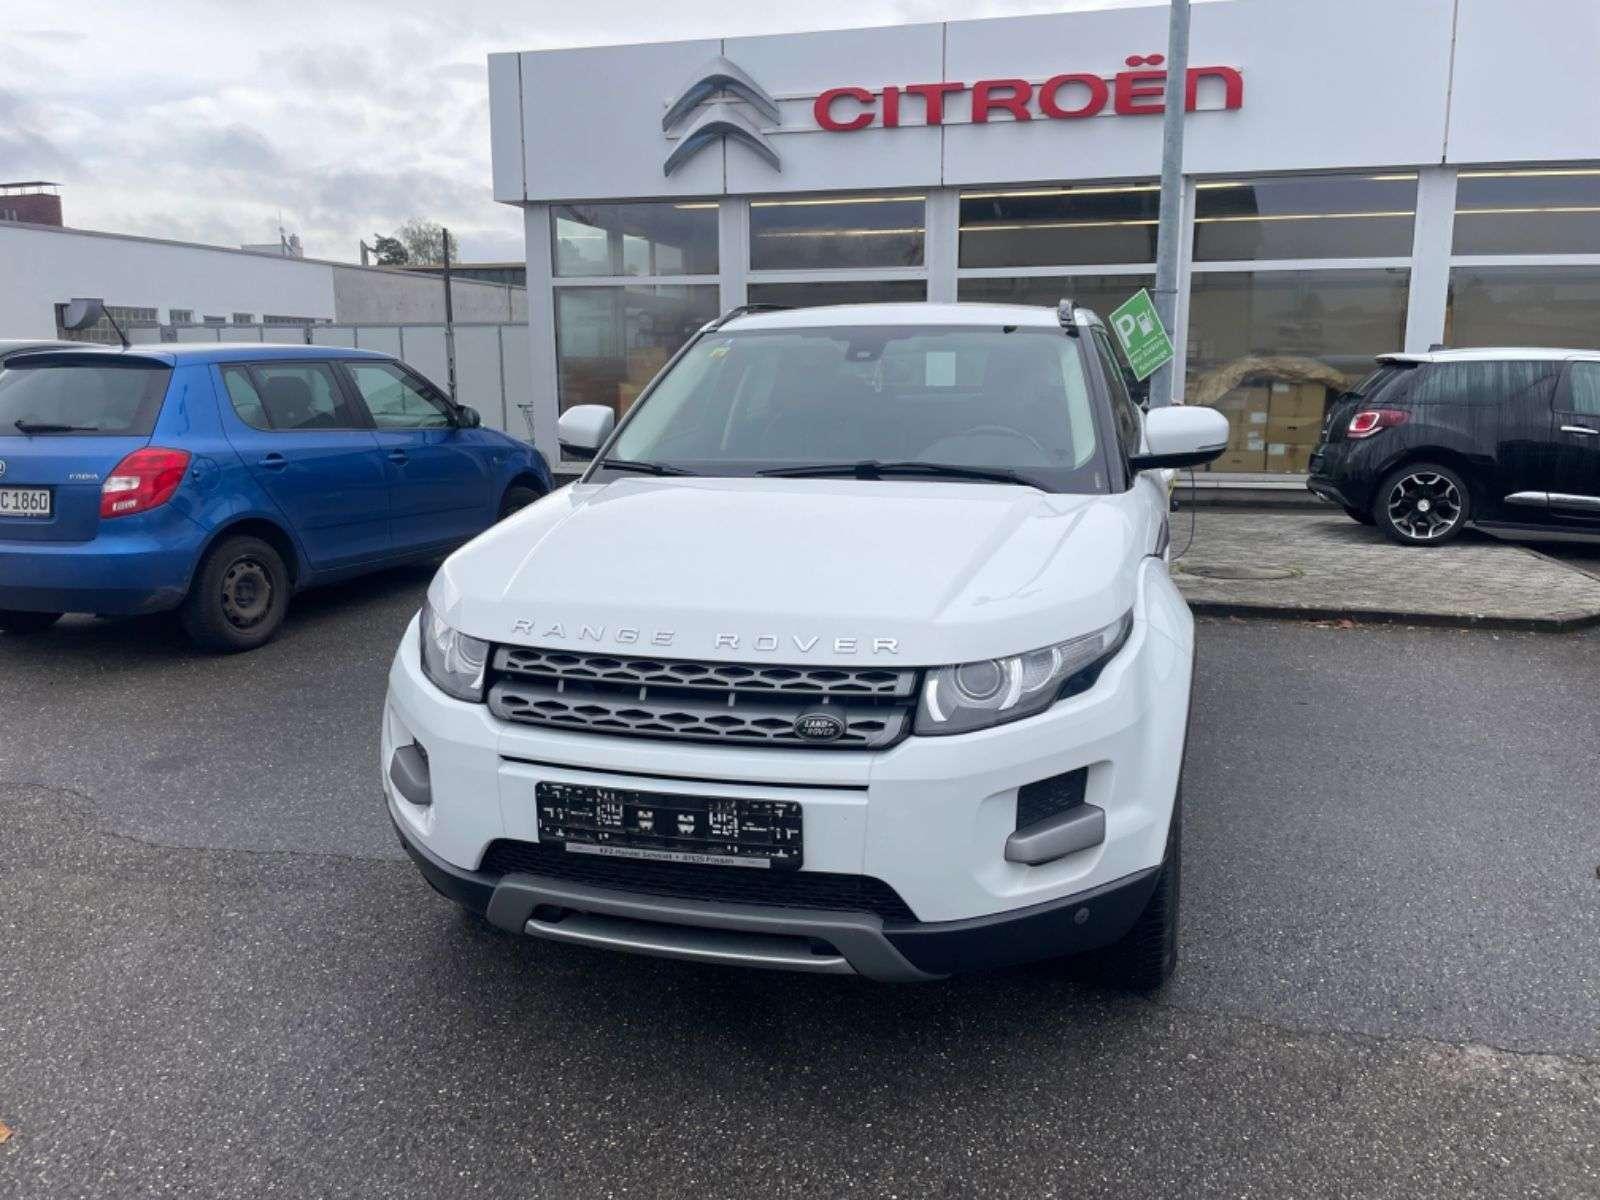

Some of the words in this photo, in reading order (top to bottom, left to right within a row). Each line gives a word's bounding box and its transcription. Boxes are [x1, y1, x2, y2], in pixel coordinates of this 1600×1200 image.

[1116, 314, 1135, 348] P
[511, 617, 675, 646] RANGE
[714, 632, 900, 654] ROVER
